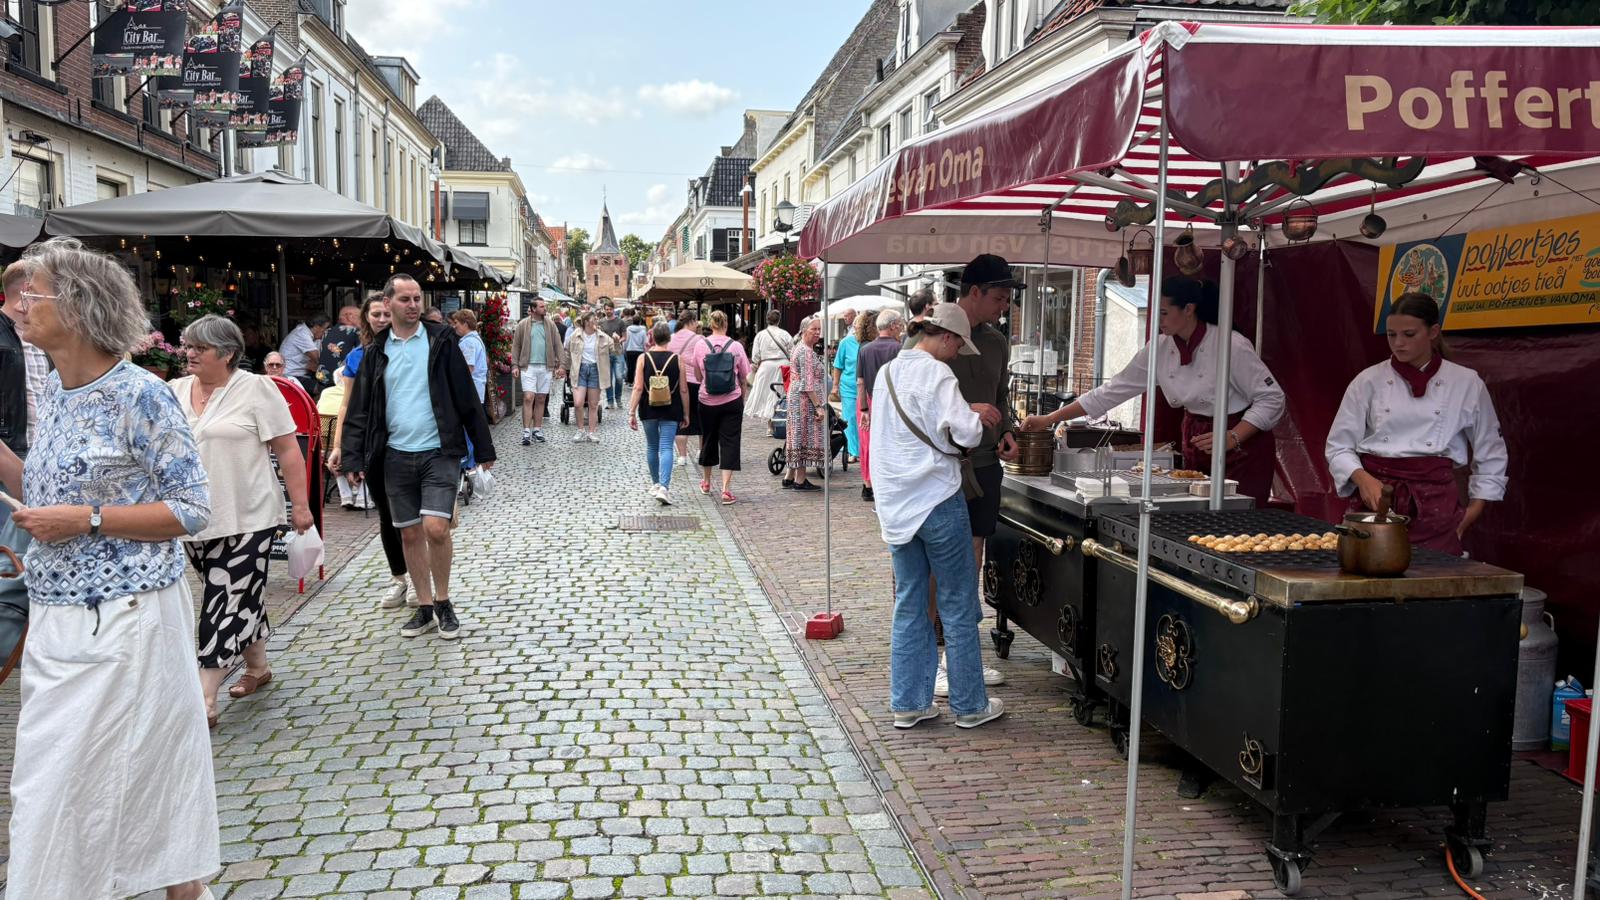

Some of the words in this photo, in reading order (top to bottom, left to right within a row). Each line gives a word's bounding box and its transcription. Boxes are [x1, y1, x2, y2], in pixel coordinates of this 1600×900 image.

[124, 30, 141, 44] City
[142, 30, 159, 43] Bar
[185, 70, 200, 82] City
[201, 69, 215, 81] Bar
[271, 114, 282, 124] Bar
[939, 146, 984, 188] Oma
[1484, 275, 1530, 300] ootjes
[1550, 294, 1569, 305] VAN
[1569, 291, 1597, 305] OMA
